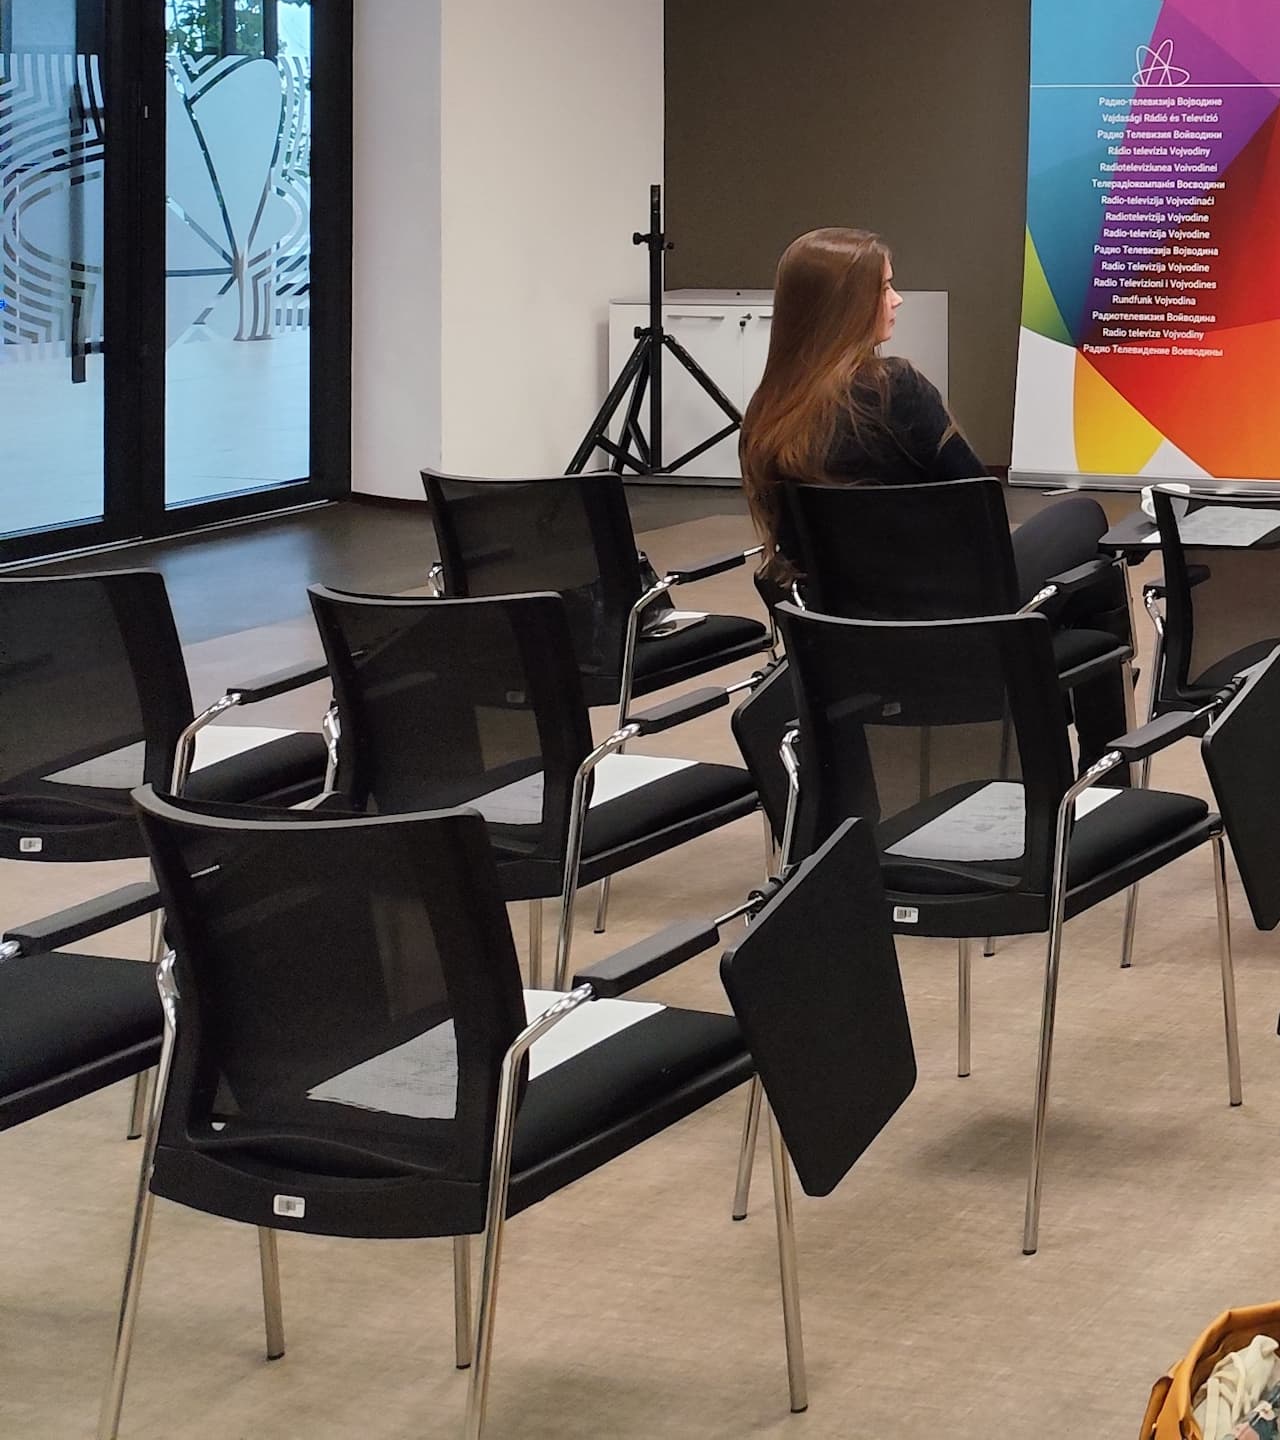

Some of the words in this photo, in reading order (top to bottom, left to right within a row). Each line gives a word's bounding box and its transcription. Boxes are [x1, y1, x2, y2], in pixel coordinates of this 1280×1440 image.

[1097, 130, 1124, 140] Радио
[1169, 146, 1211, 158] Vojvodiny
[1101, 195, 1164, 207] Radio-televizija
[1105, 212, 1166, 224] Radiotelevizija
[1167, 212, 1210, 224] Vojvodine
[1103, 228, 1167, 240] Radio-televizija
[1168, 229, 1210, 240] Vojvodine
[1094, 244, 1121, 254] Радио
[1102, 261, 1126, 271] Radio
[1127, 262, 1166, 273] Televizija
[1168, 262, 1210, 274] Vojvodine
[1094, 278, 1118, 288] Radio
[1112, 295, 1152, 304] Rundfunk
[1154, 296, 1196, 307] Vojvodina
[1102, 328, 1127, 338] Radio
[1162, 329, 1205, 341] Vojvodiny
[1082, 344, 1110, 354] Радио
